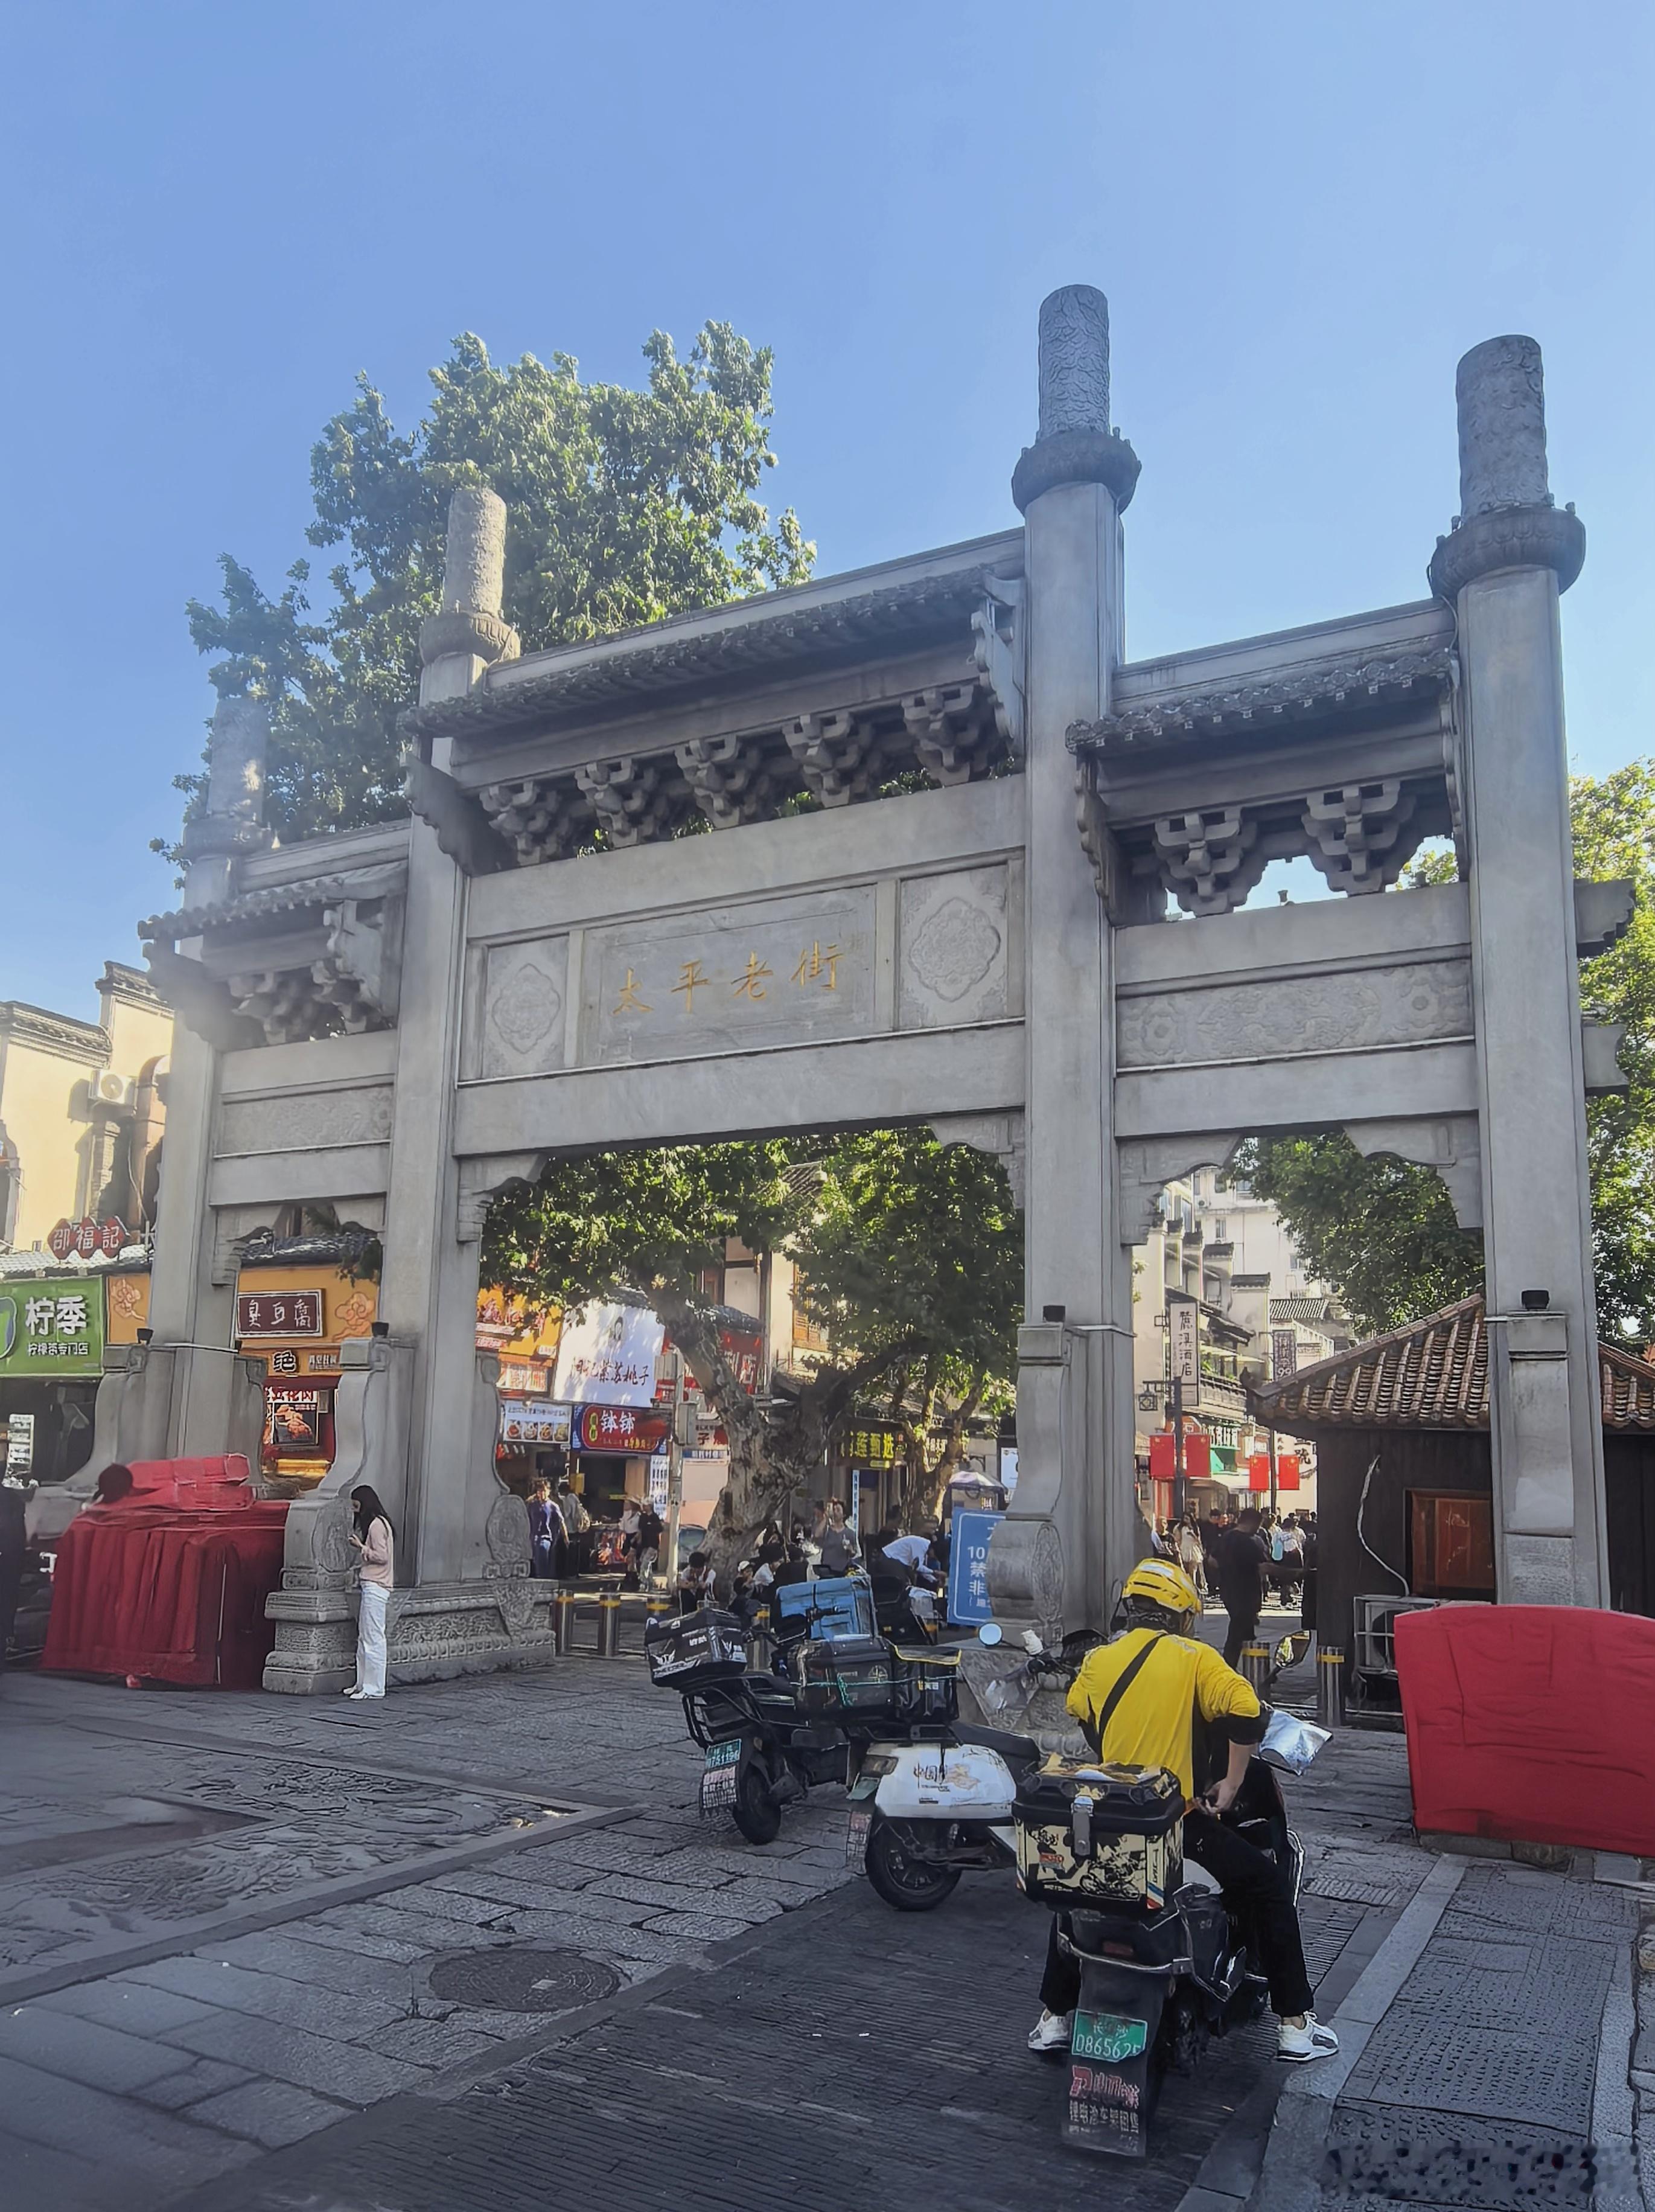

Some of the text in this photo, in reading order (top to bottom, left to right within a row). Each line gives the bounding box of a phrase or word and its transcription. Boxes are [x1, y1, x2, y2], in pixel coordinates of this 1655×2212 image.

[611, 940, 843, 1016] 太平老街
[25, 1295, 87, 1336] 柠季
[248, 1299, 311, 1328] 臭豆腐
[28, 1341, 89, 1357] 柠檬茶专门店
[273, 1350, 297, 1373] 绝
